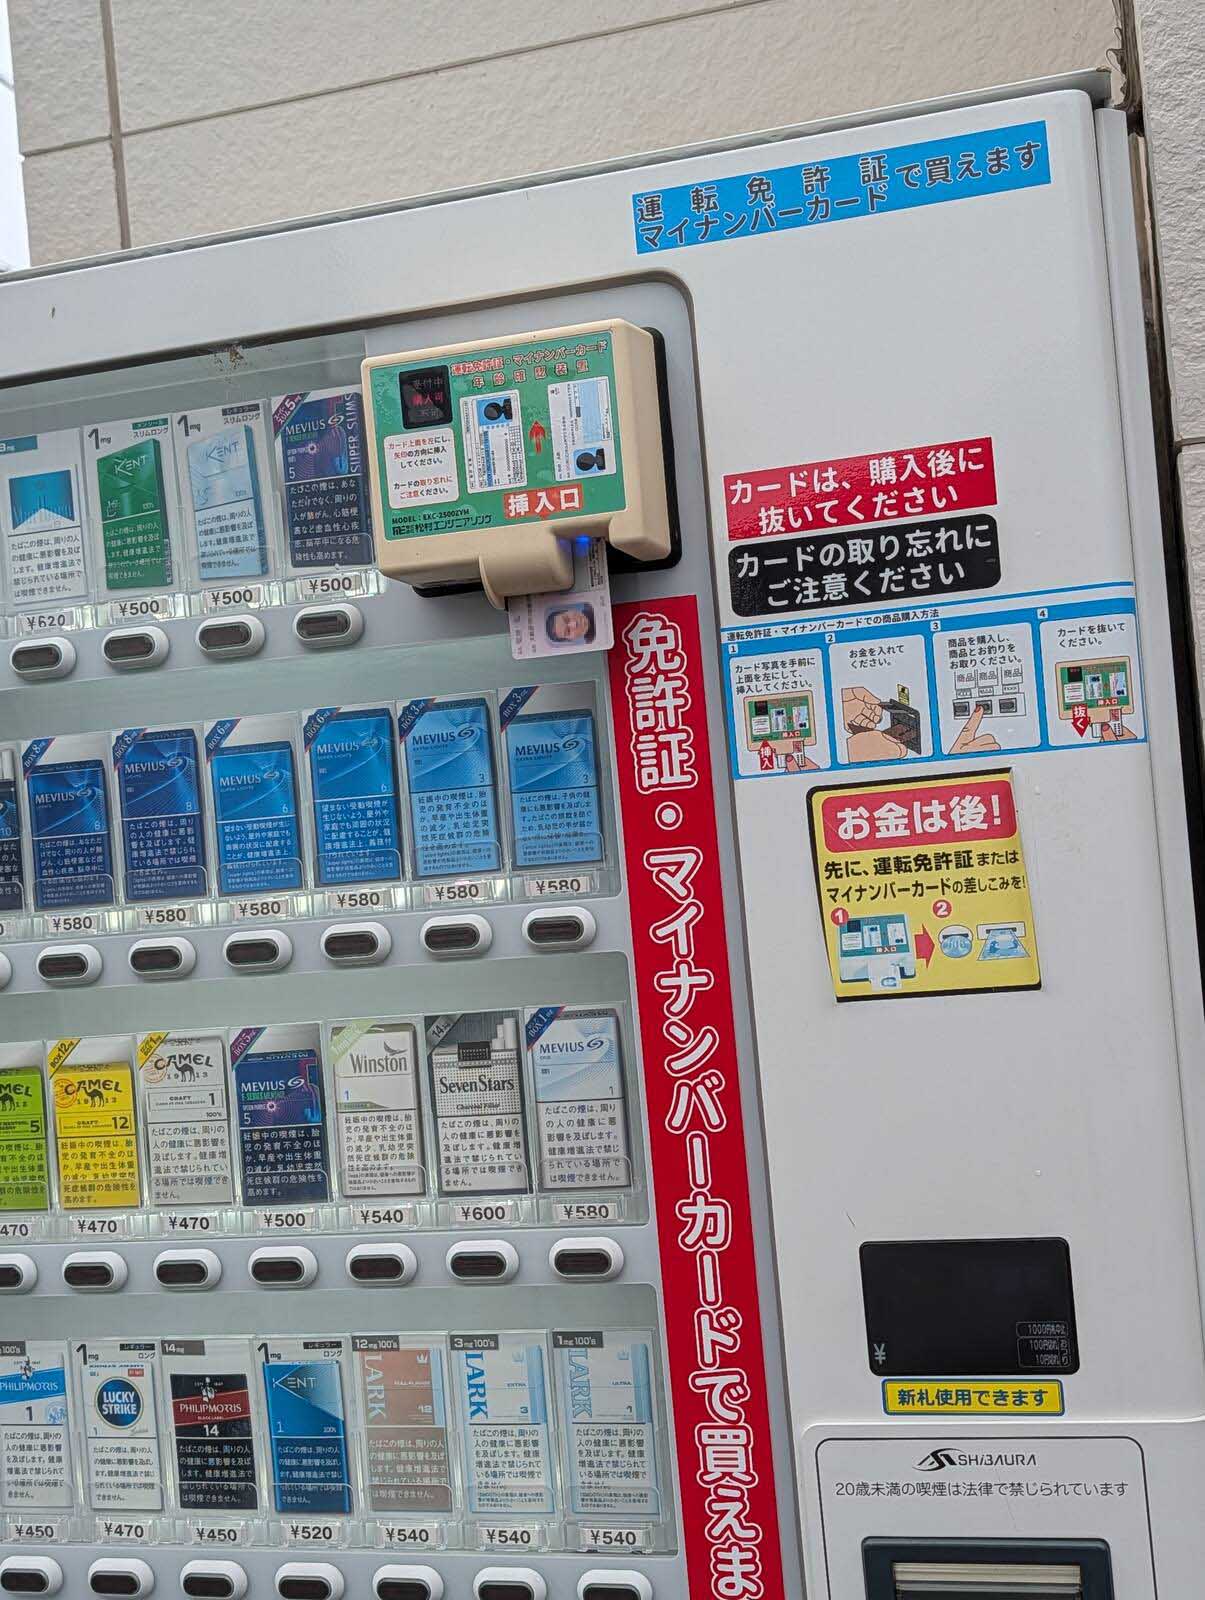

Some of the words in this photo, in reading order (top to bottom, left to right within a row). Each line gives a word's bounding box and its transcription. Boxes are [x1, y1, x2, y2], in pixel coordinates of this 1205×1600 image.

[896, 141, 1040, 188] で買えます
[637, 155, 887, 224] 運転免許証
[640, 187, 887, 248] マイナンバーカード
[285, 418, 326, 435] MEVIUS
[289, 467, 295, 478] 5
[509, 488, 580, 515] 挿入口
[758, 486, 958, 535] 抜いてください
[737, 524, 991, 578] カードの取り忘れに
[309, 577, 351, 592] ¥500
[768, 562, 964, 606] ご注意ください
[211, 590, 253, 605] ¥500
[119, 600, 159, 616] ¥500
[27, 615, 65, 630] ¥620
[727, 609, 939, 642] 運転免許証・マイナンバーカードでの商品購入方法
[933, 622, 939, 630] 3
[1058, 623, 1125, 638] カードを抜いて
[948, 634, 1010, 647] 商品を購入し、
[1059, 638, 1103, 648] ください。
[849, 644, 904, 658] お金を入れて
[949, 644, 1015, 659] 商品とお釣りを
[735, 657, 816, 673] カード写真を手前に
[850, 658, 892, 669] ください。
[950, 655, 1023, 670] お取りください。
[736, 669, 803, 684] 上面を左にして、
[736, 680, 813, 695] 挿入してください。
[1074, 707, 1085, 729] 抜く
[412, 732, 455, 745] MEVIUS
[317, 742, 359, 754] MEVIUS
[515, 743, 560, 756] MEVIUS
[761, 746, 773, 768] 挿入
[125, 762, 165, 773] MEVIUS
[220, 773, 261, 786] MEVIUS
[479, 774, 485, 783] 3
[583, 775, 589, 783] 3
[35, 791, 75, 804] MEVIUS
[283, 804, 288, 813] 6
[837, 795, 1001, 840] お金は後!
[824, 850, 1019, 880] 先に、運転免許証または
[435, 884, 479, 900] ¥580
[536, 879, 580, 894] ¥580
[826, 875, 1026, 904] マイナンバーカードの差しこみを!
[337, 893, 379, 907] ¥580
[239, 902, 281, 916] ¥580
[936, 902, 948, 915] 2
[146, 909, 186, 923] ¥580
[835, 910, 843, 923] 1
[53, 917, 92, 930] ¥580
[539, 1041, 585, 1054] MEVIUS
[154, 1053, 213, 1068] CAMEL
[350, 1054, 408, 1073] Winston
[64, 1079, 122, 1096] CAMEL
[241, 1080, 285, 1092] MEVIUS
[209, 1093, 215, 1106] 1
[344, 1090, 350, 1100] 1
[112, 1116, 129, 1130] 12
[243, 1113, 251, 1124] 5
[30, 1120, 40, 1133] 5
[361, 1210, 403, 1224] ¥540
[461, 1206, 505, 1220] ¥600
[564, 1205, 609, 1219] ¥580
[78, 1220, 117, 1233] ¥470
[169, 1217, 209, 1230] ¥470
[264, 1214, 306, 1228] ¥500
[323, 1350, 342, 1358] ロング
[874, 1343, 886, 1364] ¥
[364, 1353, 386, 1420] LARK
[465, 1352, 488, 1420] LARK
[568, 1349, 592, 1419] LARK
[103, 1391, 135, 1403] LUCKY
[898, 1389, 1049, 1408] 新札使用できます
[25, 1406, 33, 1421] 1
[102, 1403, 137, 1415] STRIKE
[520, 1406, 528, 1414] 3
[204, 1424, 219, 1437] 14
[277, 1421, 284, 1433] 1
[835, 1481, 1128, 1498] 20歳未満の喫煙は法律で禁じられています
[15, 1525, 54, 1538] ¥450
[104, 1522, 144, 1537] ¥470
[197, 1528, 237, 1542] ¥450
[291, 1525, 332, 1540] ¥520
[386, 1528, 429, 1543] ¥540
[487, 1529, 530, 1544] ¥540
[591, 1530, 636, 1545] ¥540
